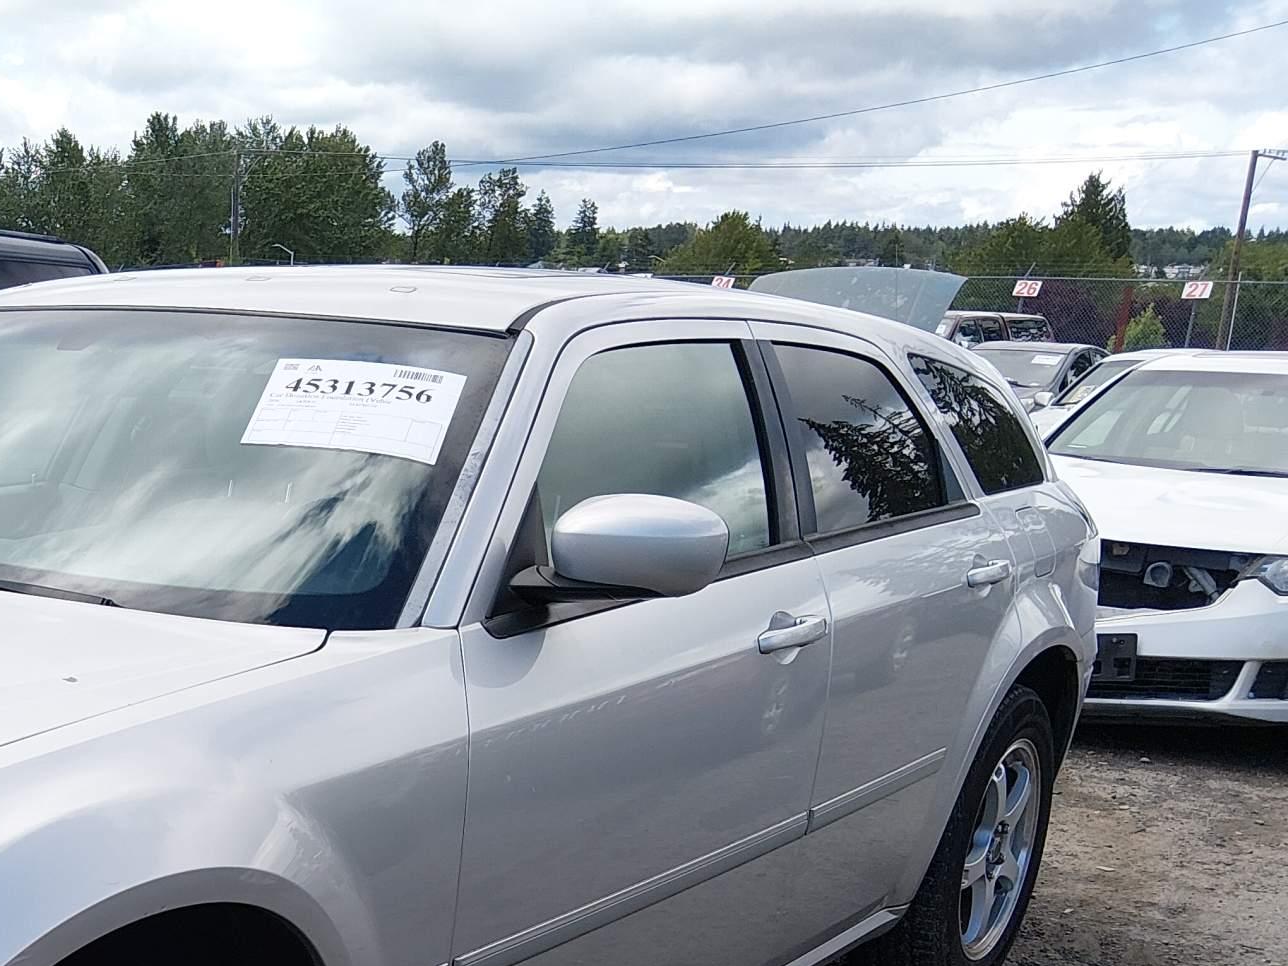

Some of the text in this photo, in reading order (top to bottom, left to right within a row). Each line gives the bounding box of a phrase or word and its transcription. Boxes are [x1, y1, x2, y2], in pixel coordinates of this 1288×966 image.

[1015, 281, 1039, 296] 26
[1185, 282, 1210, 298] 27
[285, 377, 436, 404] 45313756
